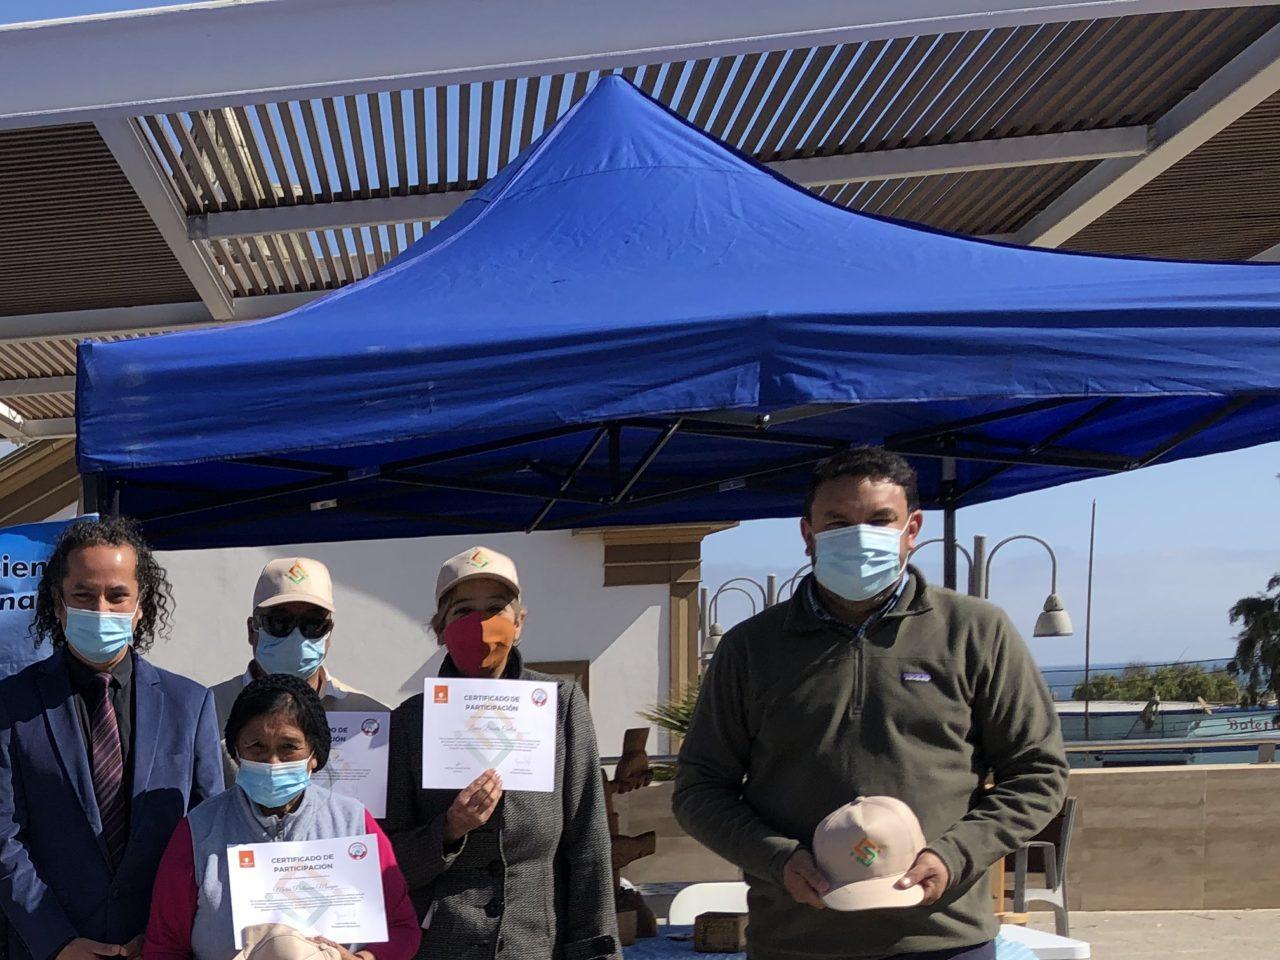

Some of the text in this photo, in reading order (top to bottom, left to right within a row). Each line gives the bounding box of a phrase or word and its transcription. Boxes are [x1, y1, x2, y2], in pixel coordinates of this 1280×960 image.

[463, 694, 520, 703] CERTIFICADO DE
[465, 704, 519, 712] PARTICIPACIÓN
[271, 853, 335, 864] CERTIFICADO DE
[273, 862, 333, 873] PARTICIPACIÓN
